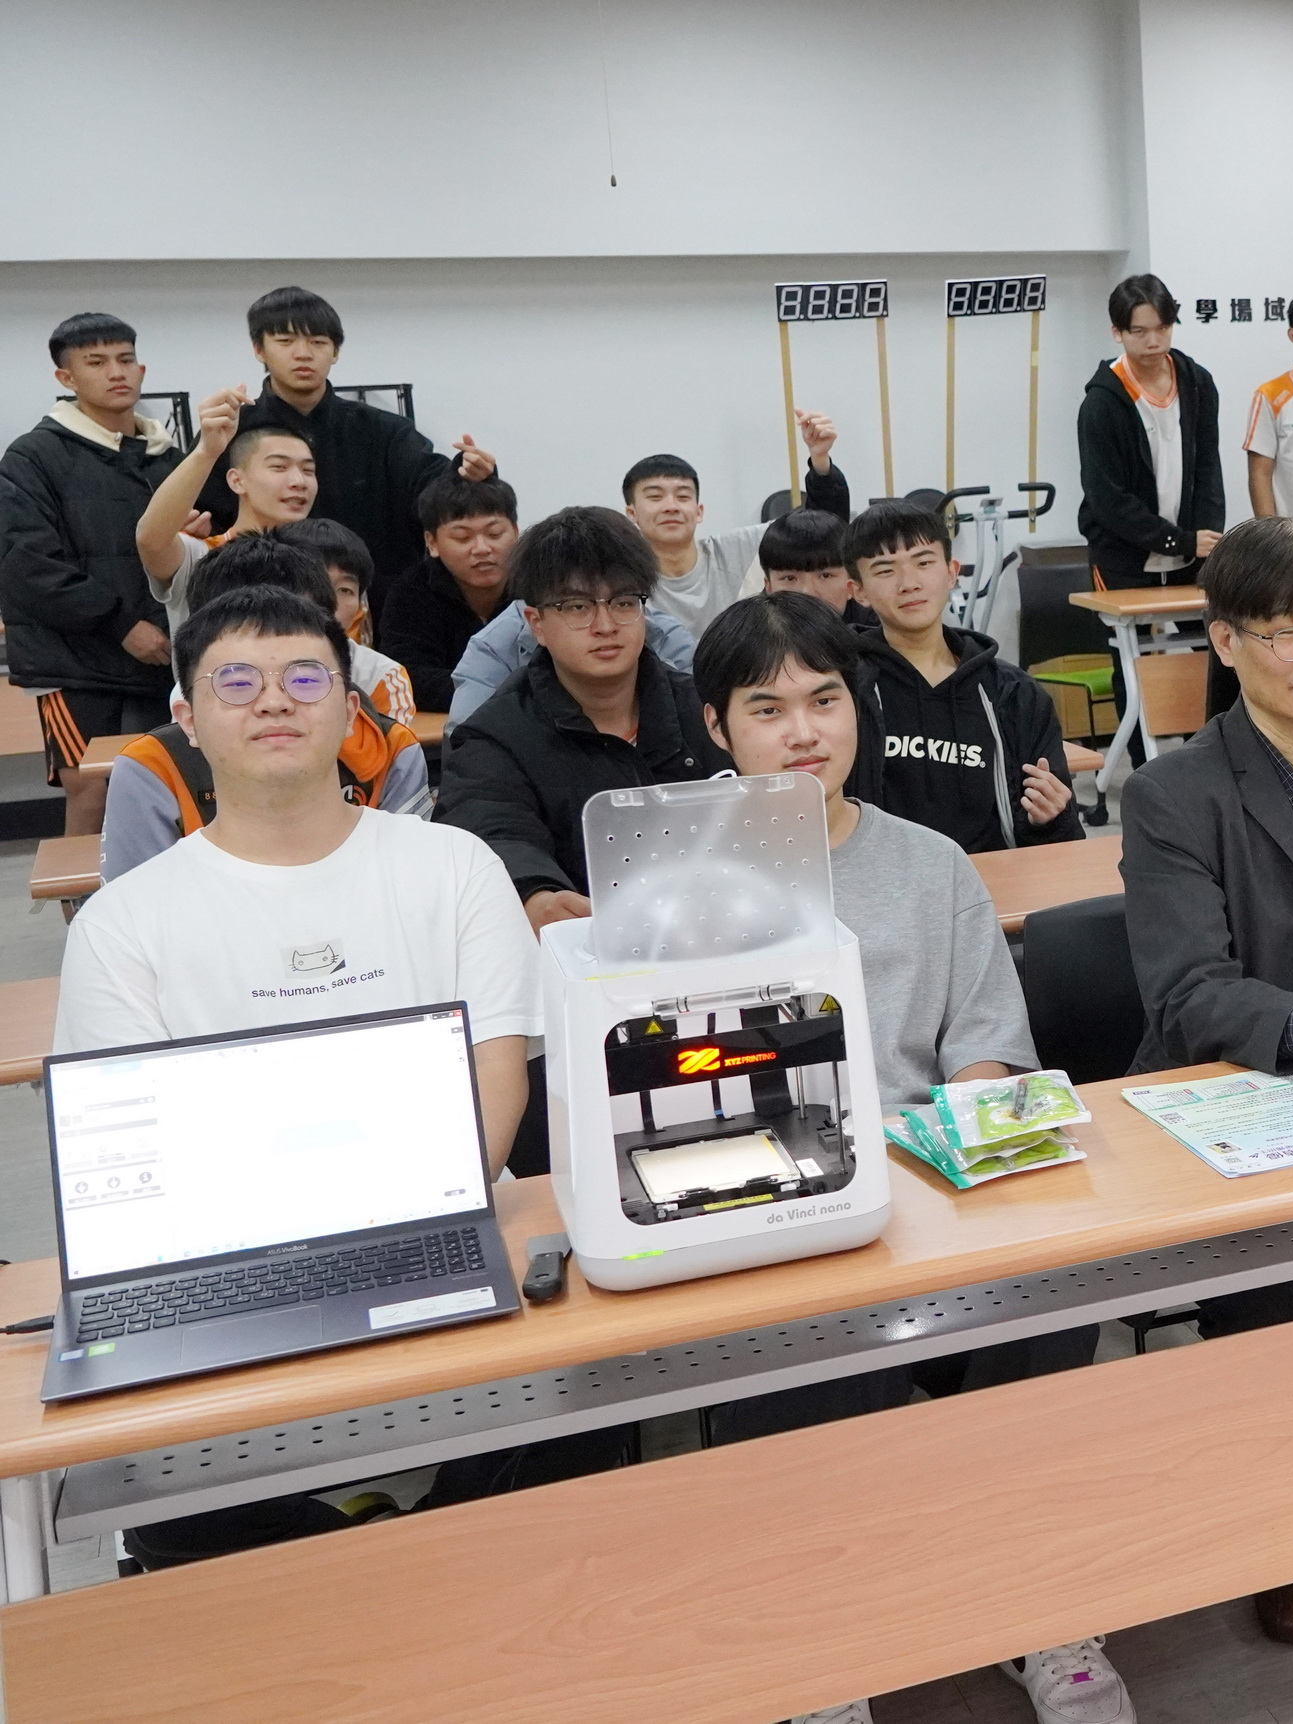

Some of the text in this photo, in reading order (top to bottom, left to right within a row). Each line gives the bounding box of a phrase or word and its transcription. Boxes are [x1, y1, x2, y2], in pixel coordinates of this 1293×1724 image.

[252, 968, 385, 998] save humans, save cats
[724, 1051, 777, 1067] XYZPRINTING
[766, 1201, 852, 1225] da Vinci nano
